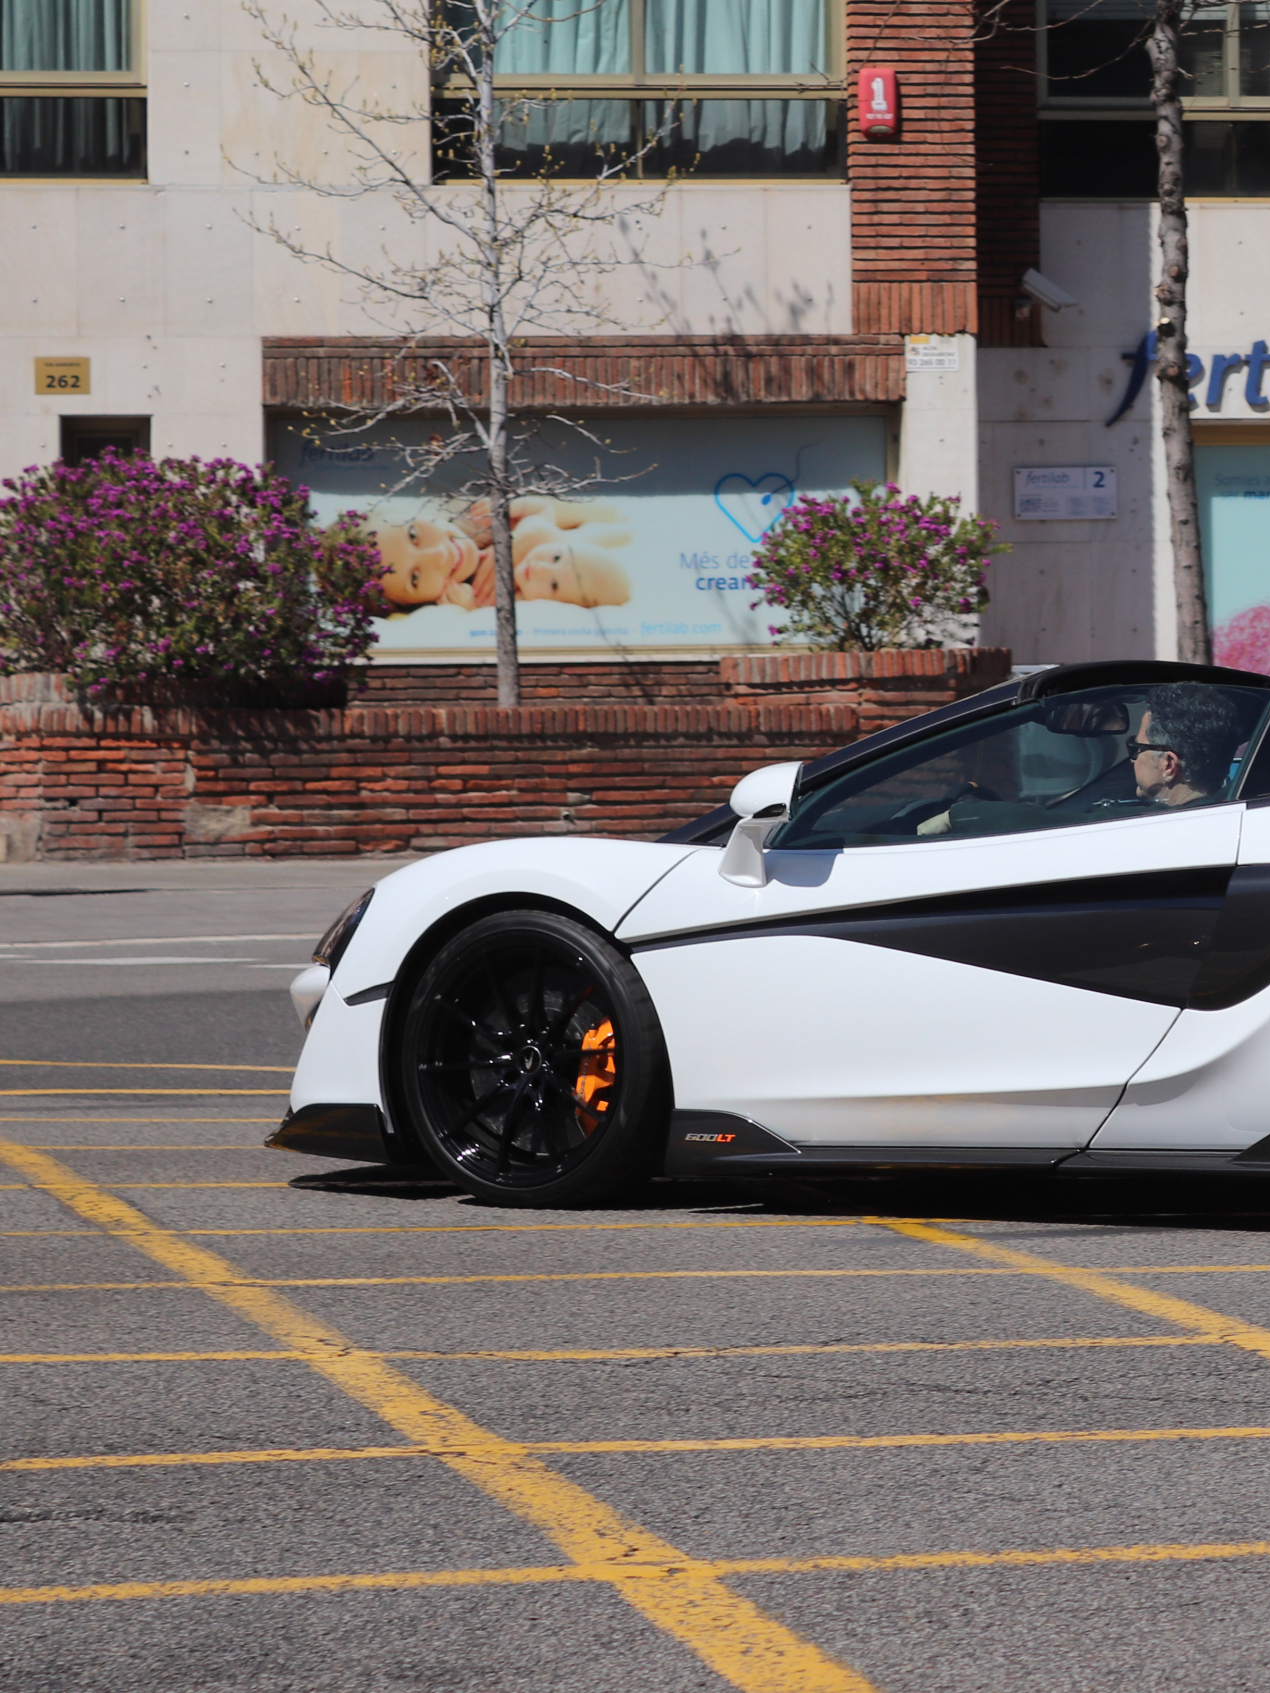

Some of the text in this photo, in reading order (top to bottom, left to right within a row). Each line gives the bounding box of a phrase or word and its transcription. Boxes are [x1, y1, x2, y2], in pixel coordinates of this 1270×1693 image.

[46, 375, 81, 388] 262
[1025, 470, 1070, 488] fertilab
[1093, 471, 1106, 488] 2
[680, 551, 750, 569] Més de
[685, 1133, 736, 1142] 600LT
